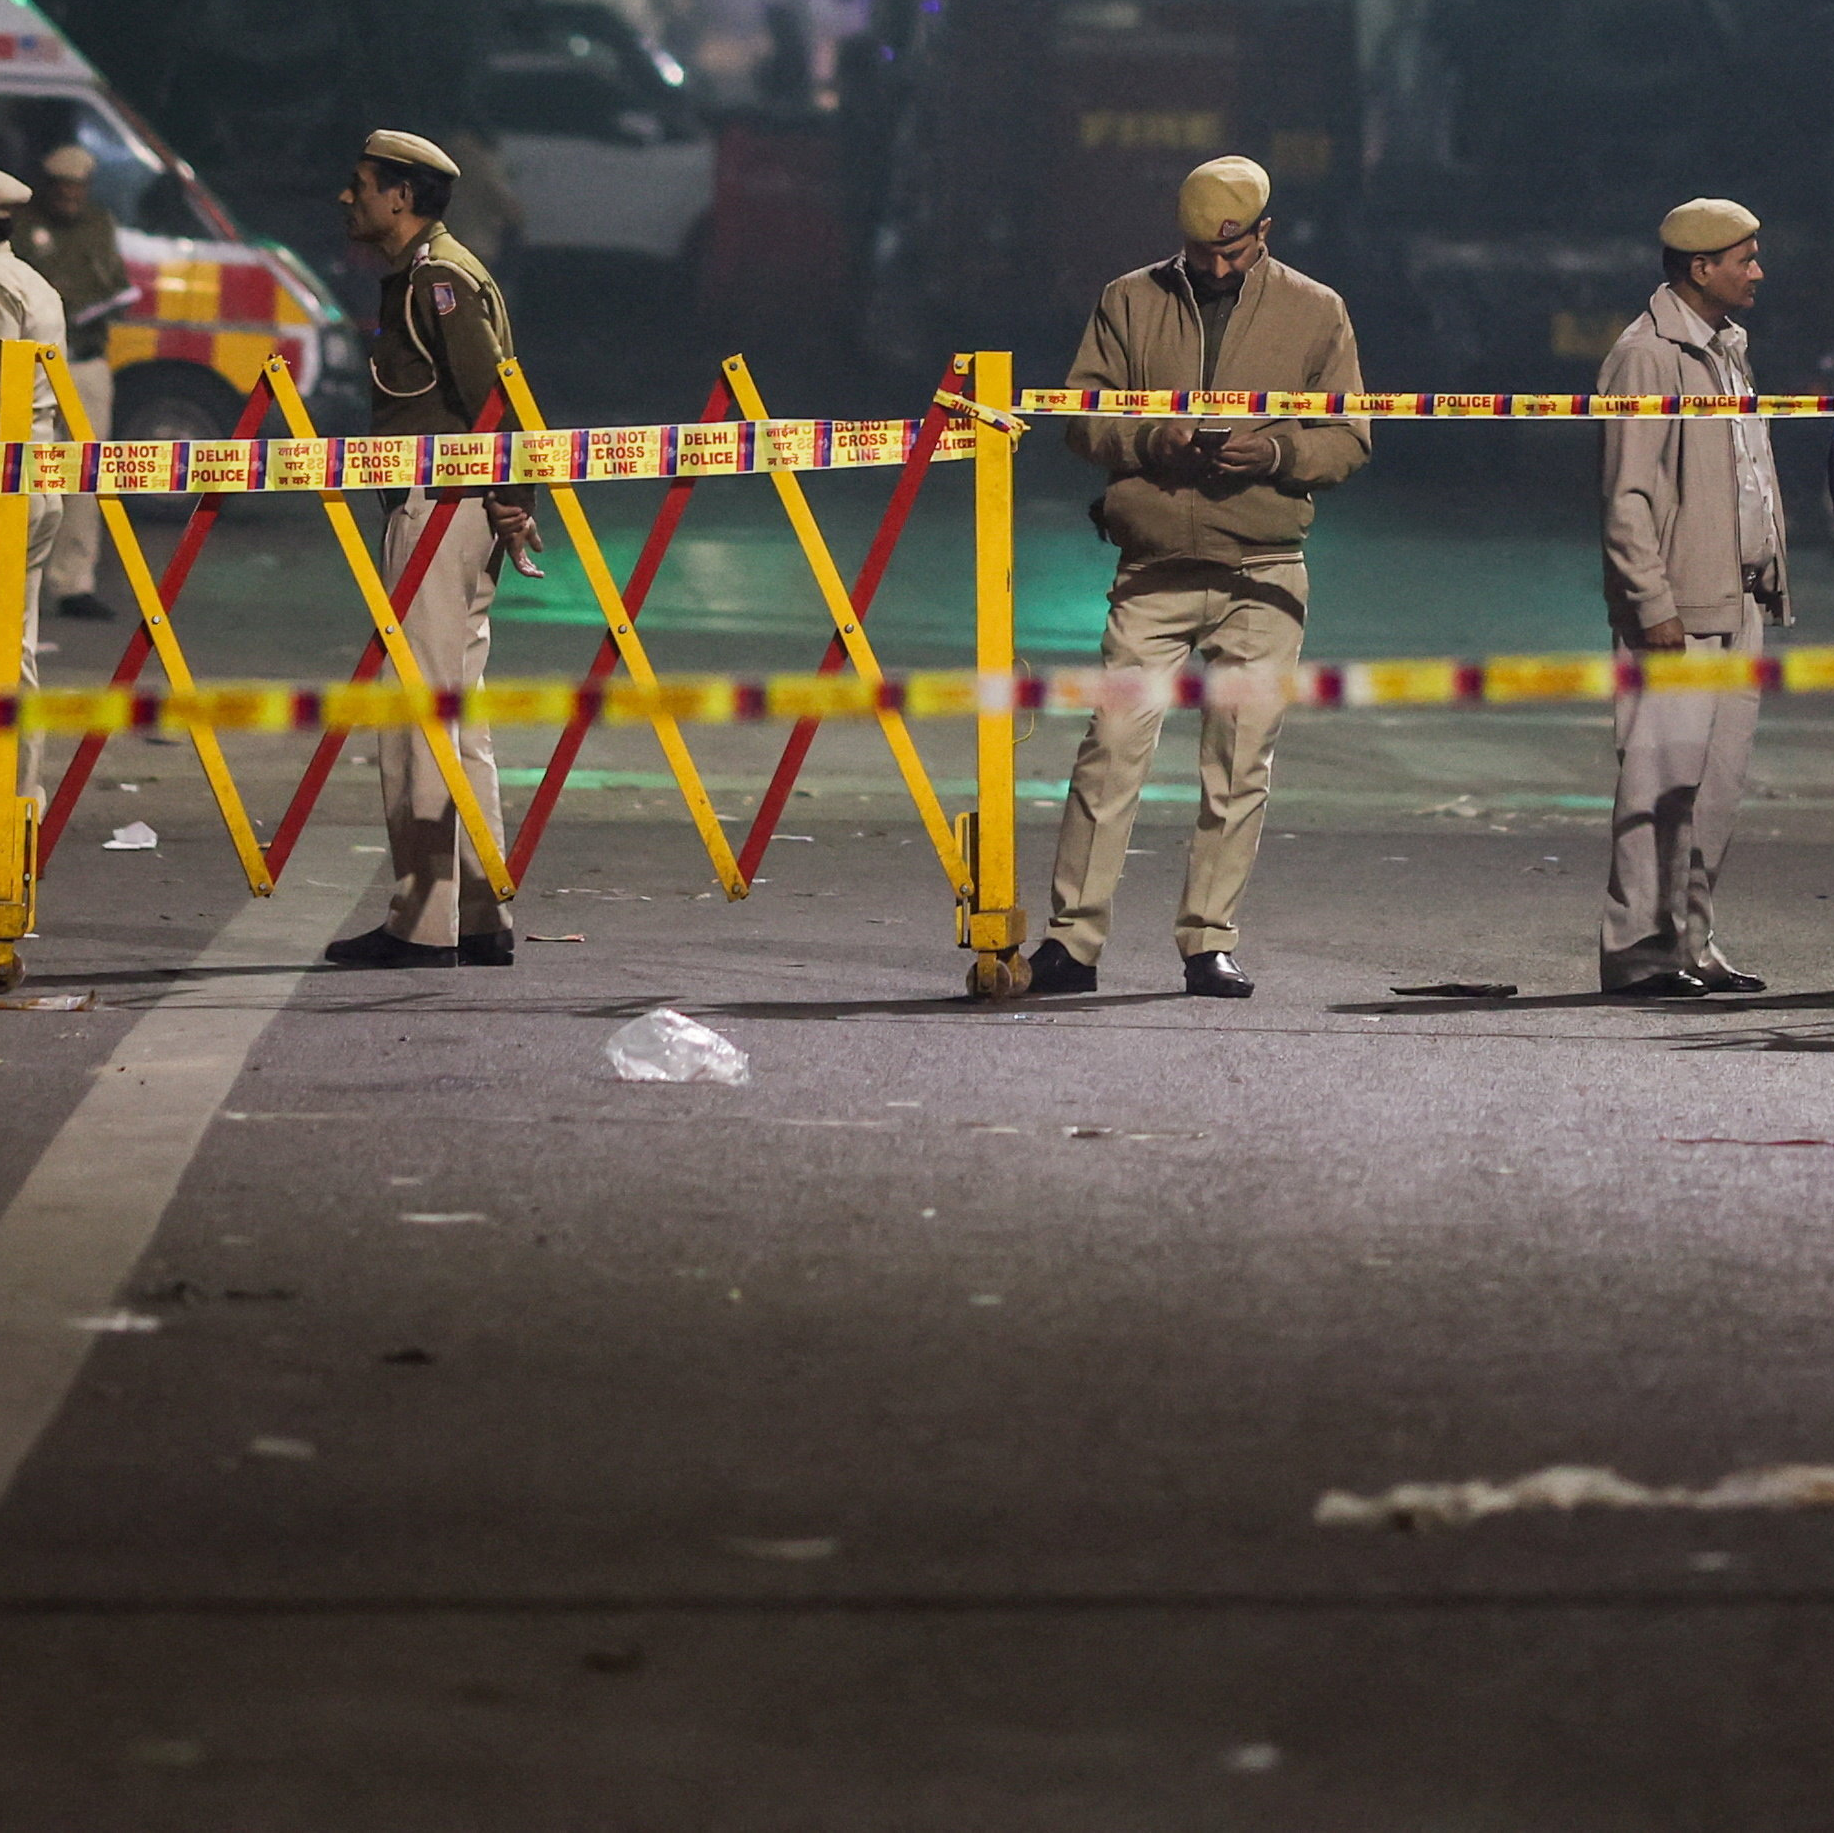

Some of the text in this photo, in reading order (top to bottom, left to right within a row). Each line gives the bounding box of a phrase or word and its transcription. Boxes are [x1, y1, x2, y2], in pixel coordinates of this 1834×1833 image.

[1116, 395, 1149, 406] LINE
[1193, 392, 1245, 404] POLICE
[1437, 396, 1491, 408] POLICE
[1682, 397, 1737, 407] POLICE
[1361, 400, 1394, 411] LINE
[1606, 401, 1639, 410] LINE
[835, 420, 888, 432] DO NOT
[592, 431, 646, 445] DO NOT
[684, 432, 727, 446] DELHI
[838, 433, 887, 447] CROSS
[103, 446, 158, 458] DO NOT
[348, 441, 403, 453] DO NOT
[440, 443, 483, 456] DELHI
[595, 446, 644, 459] CROSS
[772, 442, 791, 451] पार
[196, 450, 239, 462] DELHI
[528, 454, 548, 463] पार
[680, 452, 733, 466] POLICE
[848, 448, 880, 461] LINE
[106, 461, 155, 473] CROSS
[284, 462, 303, 470] पार
[352, 456, 400, 468] CROSS
[605, 462, 637, 474] LINE
[767, 458, 777, 466] न
[40, 465, 60, 473] पार
[437, 463, 489, 476] POLICE
[115, 476, 147, 488] LINE
[192, 470, 244, 482] POLICE
[279, 477, 288, 485] न
[360, 471, 392, 483] LINE
[34, 480, 43, 488] न
